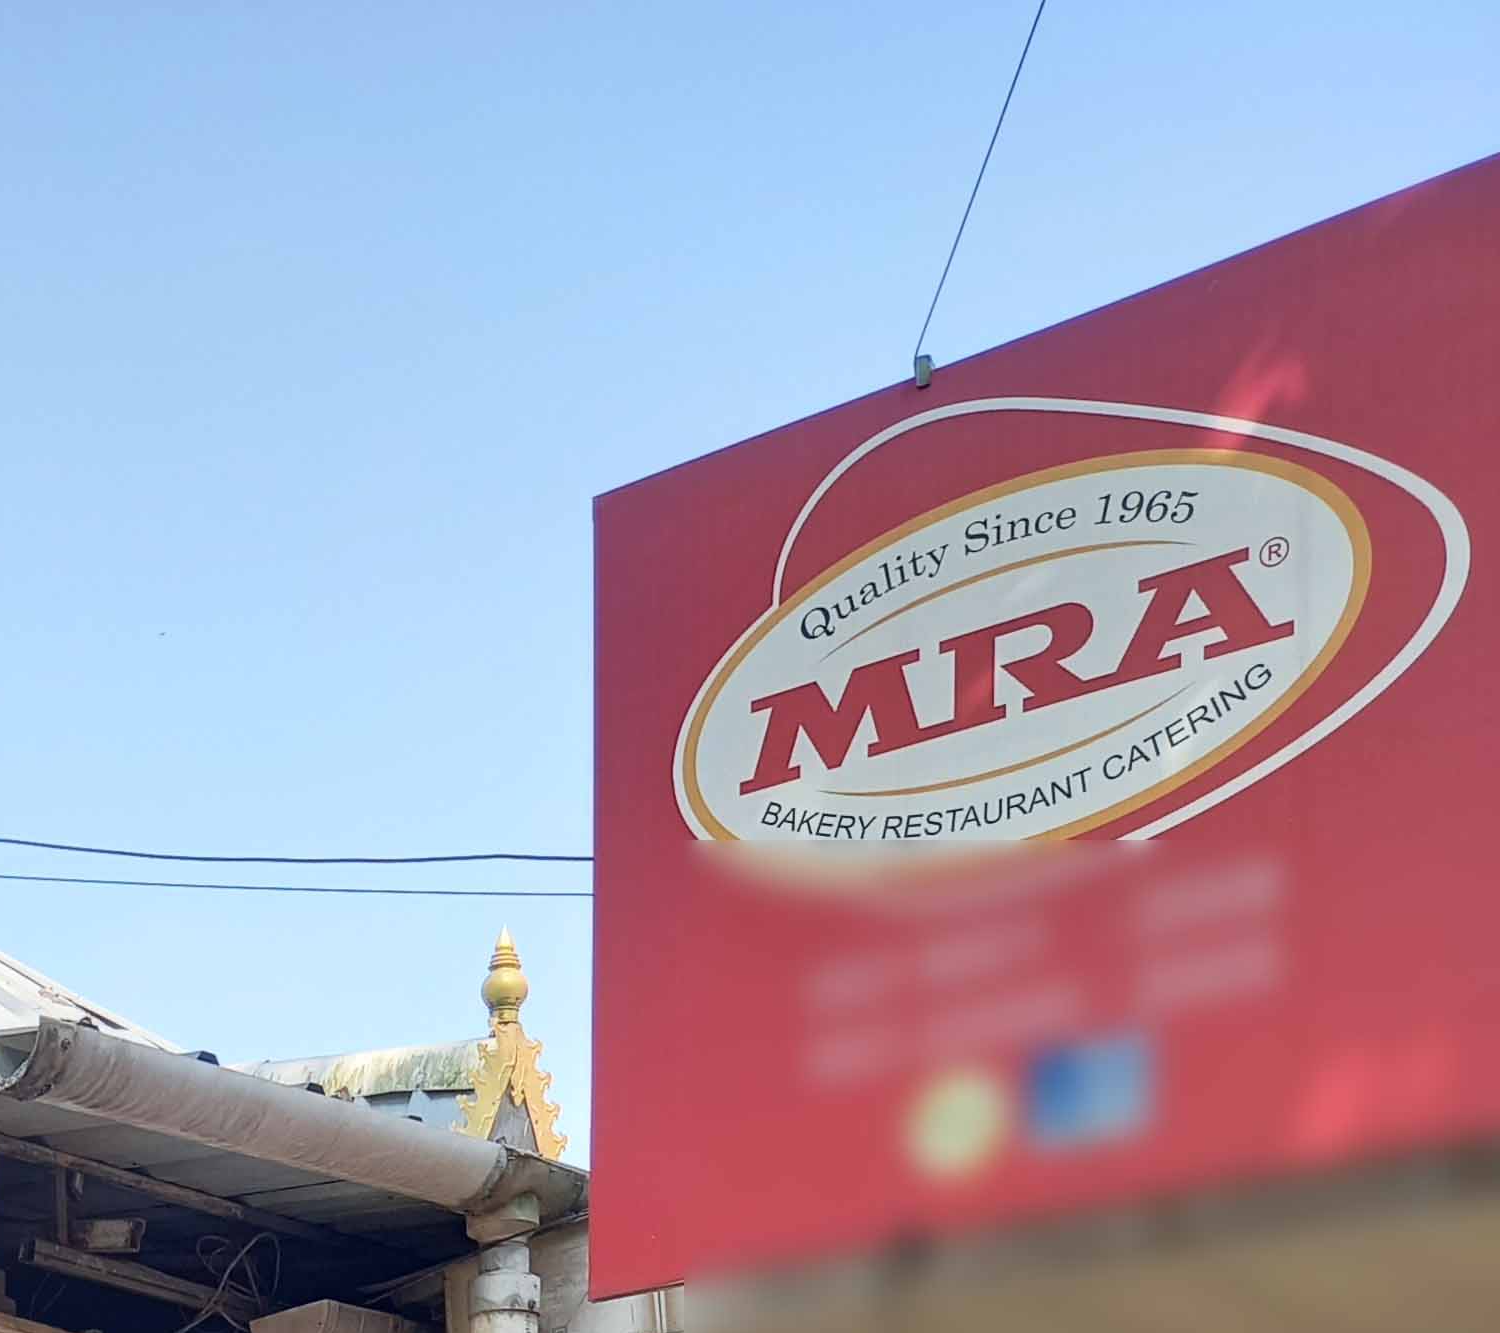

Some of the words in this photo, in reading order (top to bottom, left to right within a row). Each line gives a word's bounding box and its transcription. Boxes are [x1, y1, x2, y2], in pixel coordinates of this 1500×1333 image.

[800, 544, 949, 641] Quality
[964, 508, 1077, 556] Since
[1093, 490, 1199, 526] 1965
[739, 547, 1295, 796] MRA
[761, 801, 876, 839] BAKERY
[881, 766, 1092, 840] RESTAURANT
[1102, 662, 1273, 780] CATERING
